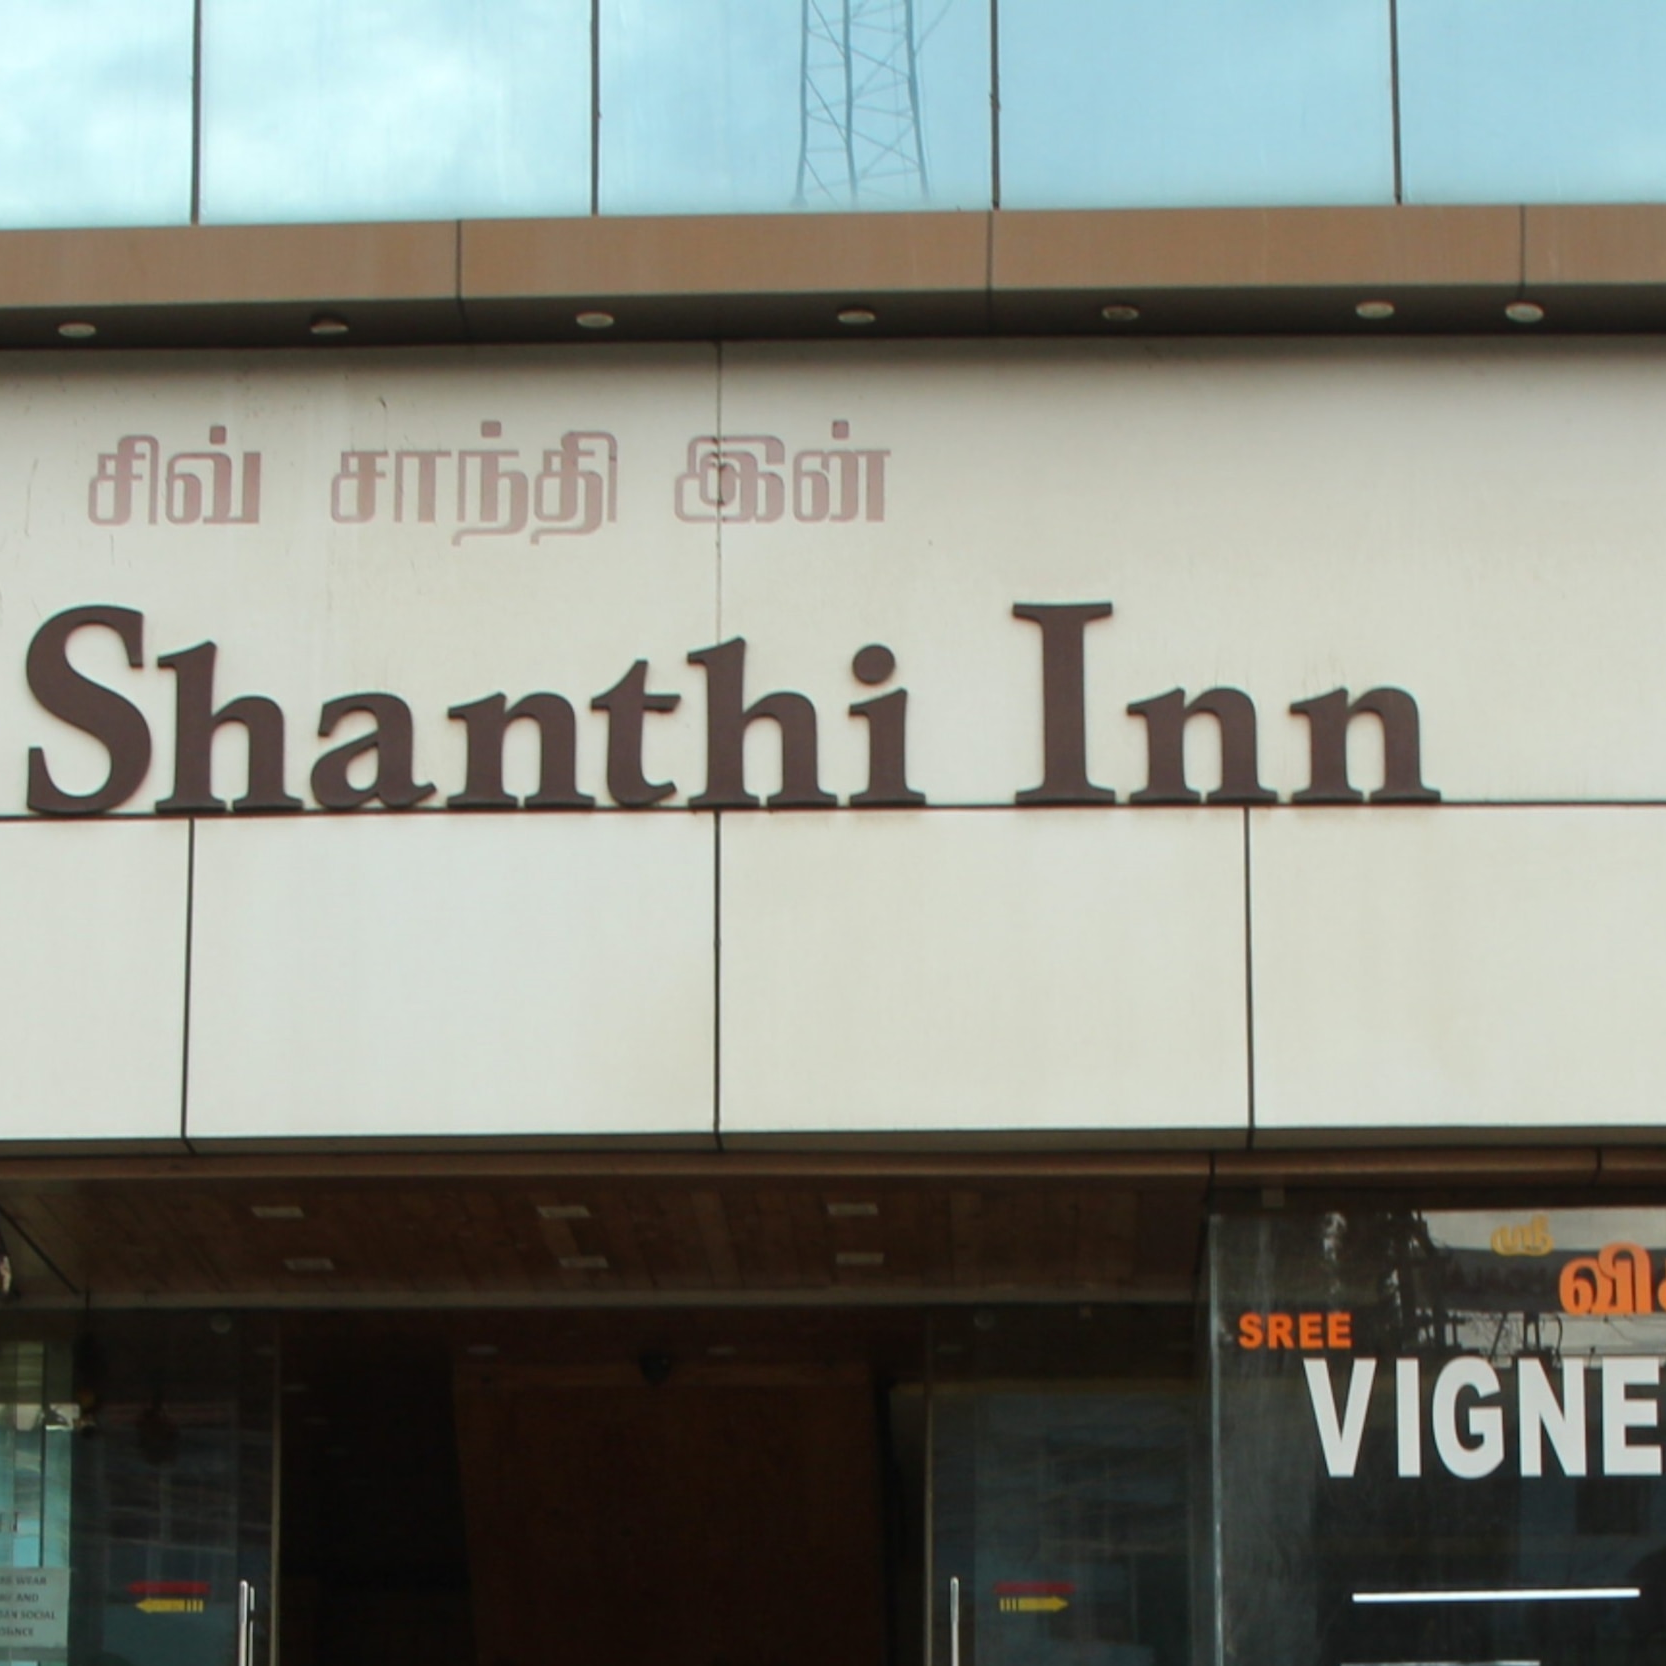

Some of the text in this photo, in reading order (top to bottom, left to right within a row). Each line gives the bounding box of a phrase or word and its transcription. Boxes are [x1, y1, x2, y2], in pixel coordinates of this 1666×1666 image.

[88, 420, 892, 547] சிவ் சாந்தி இன்
[23, 604, 927, 816] Shanthi
[1012, 600, 1442, 806] Inn
[1238, 1312, 1353, 1349] SREE
